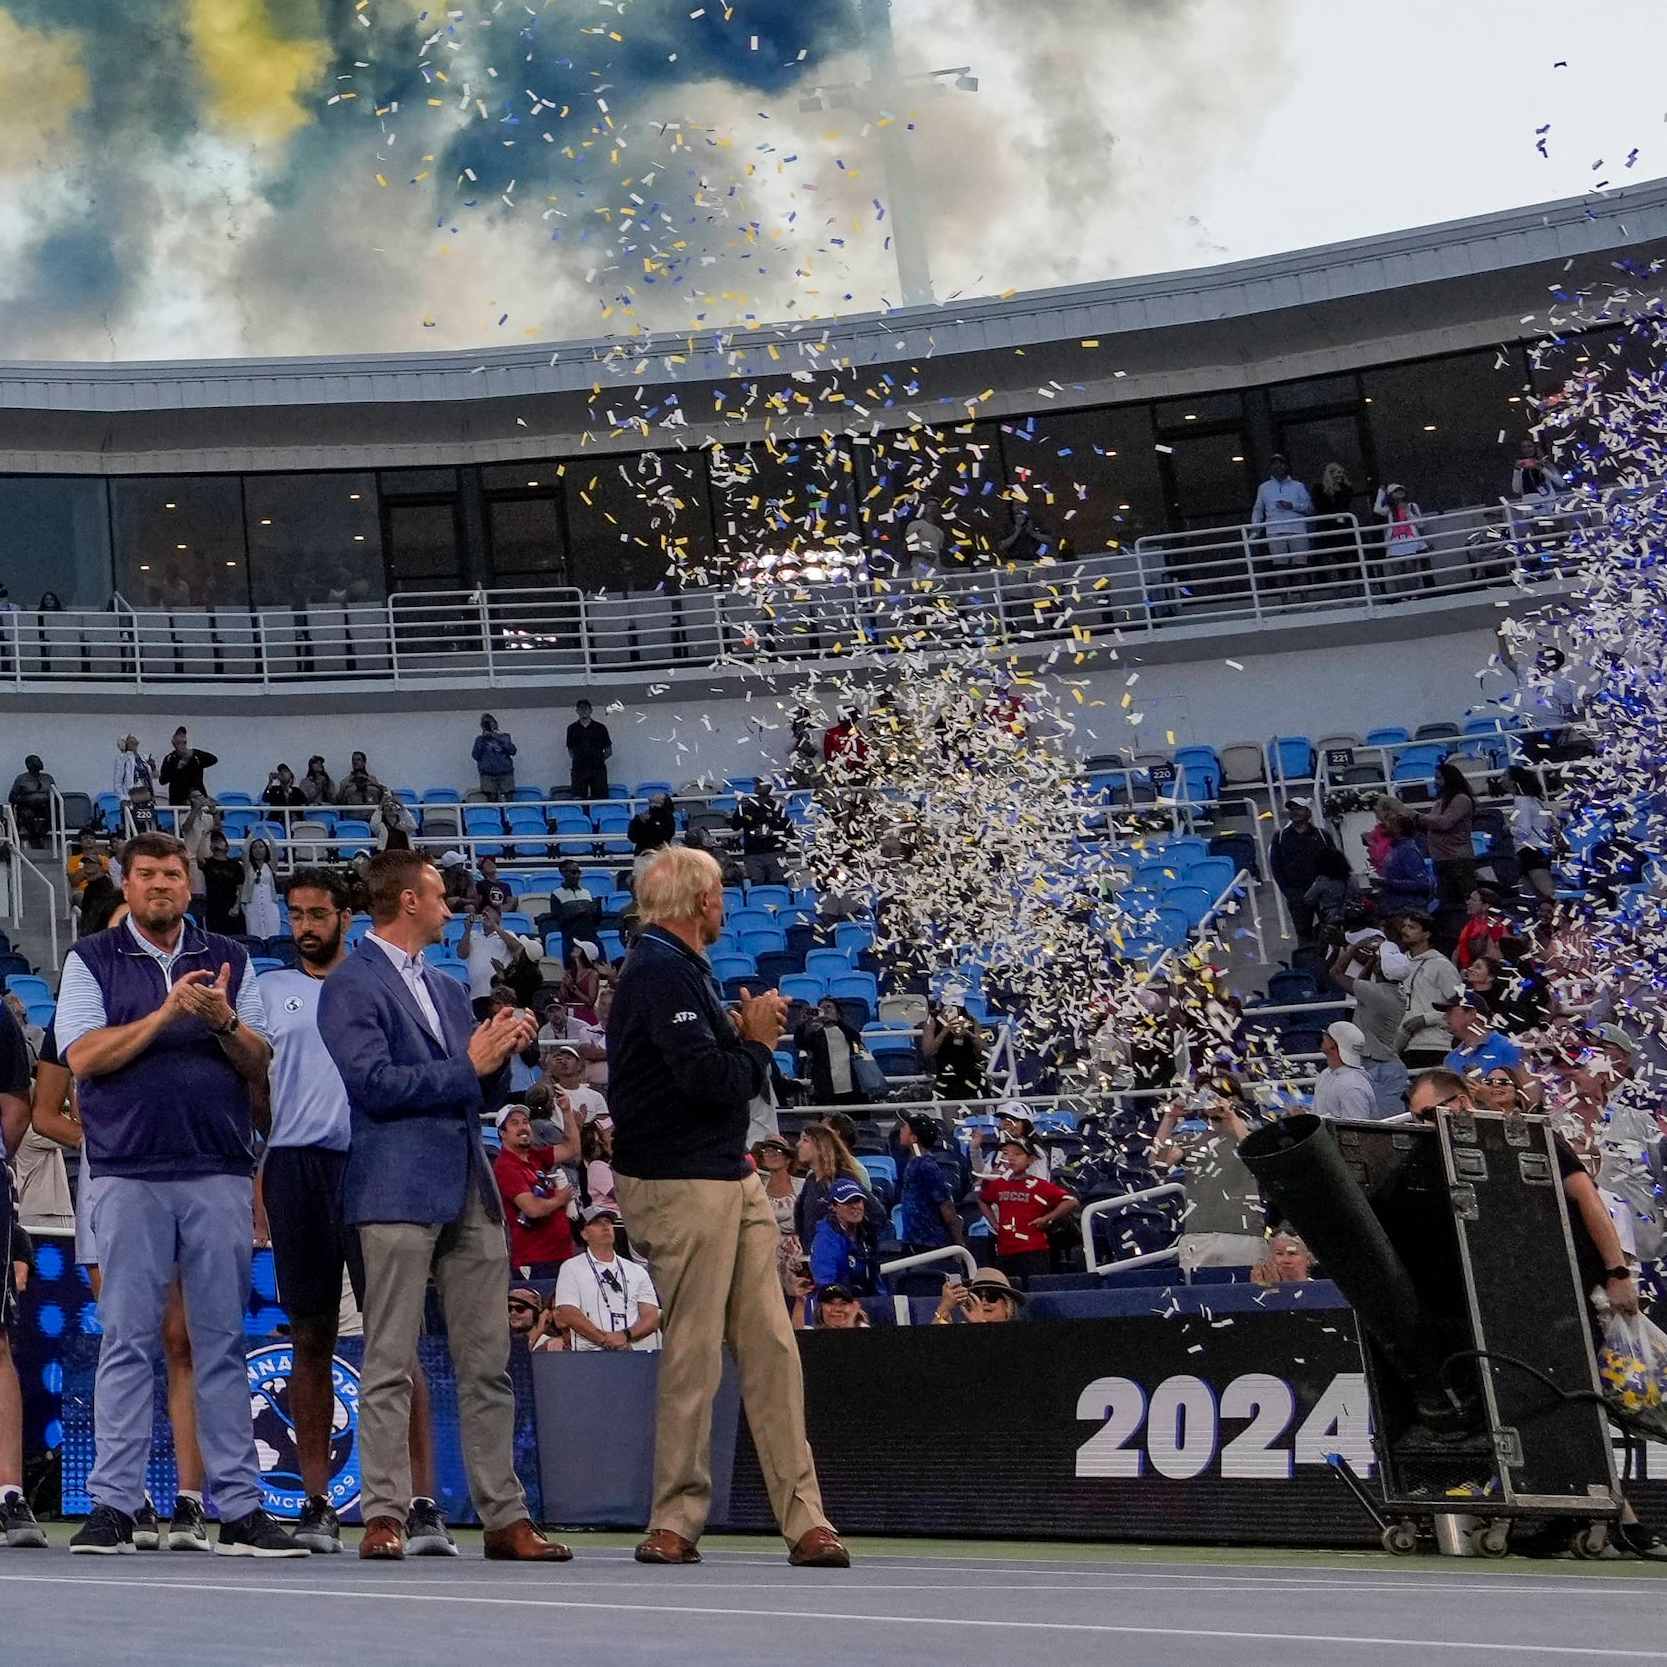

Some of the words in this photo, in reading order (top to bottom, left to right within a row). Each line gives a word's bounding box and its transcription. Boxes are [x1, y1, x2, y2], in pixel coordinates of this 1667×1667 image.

[1332, 754, 1349, 764] 221
[1154, 770, 1172, 780] 220
[136, 810, 153, 820] 220
[672, 1011, 697, 1024] ATP
[332, 1369, 360, 1415] OPE
[1075, 1373, 1376, 1480] 2024
